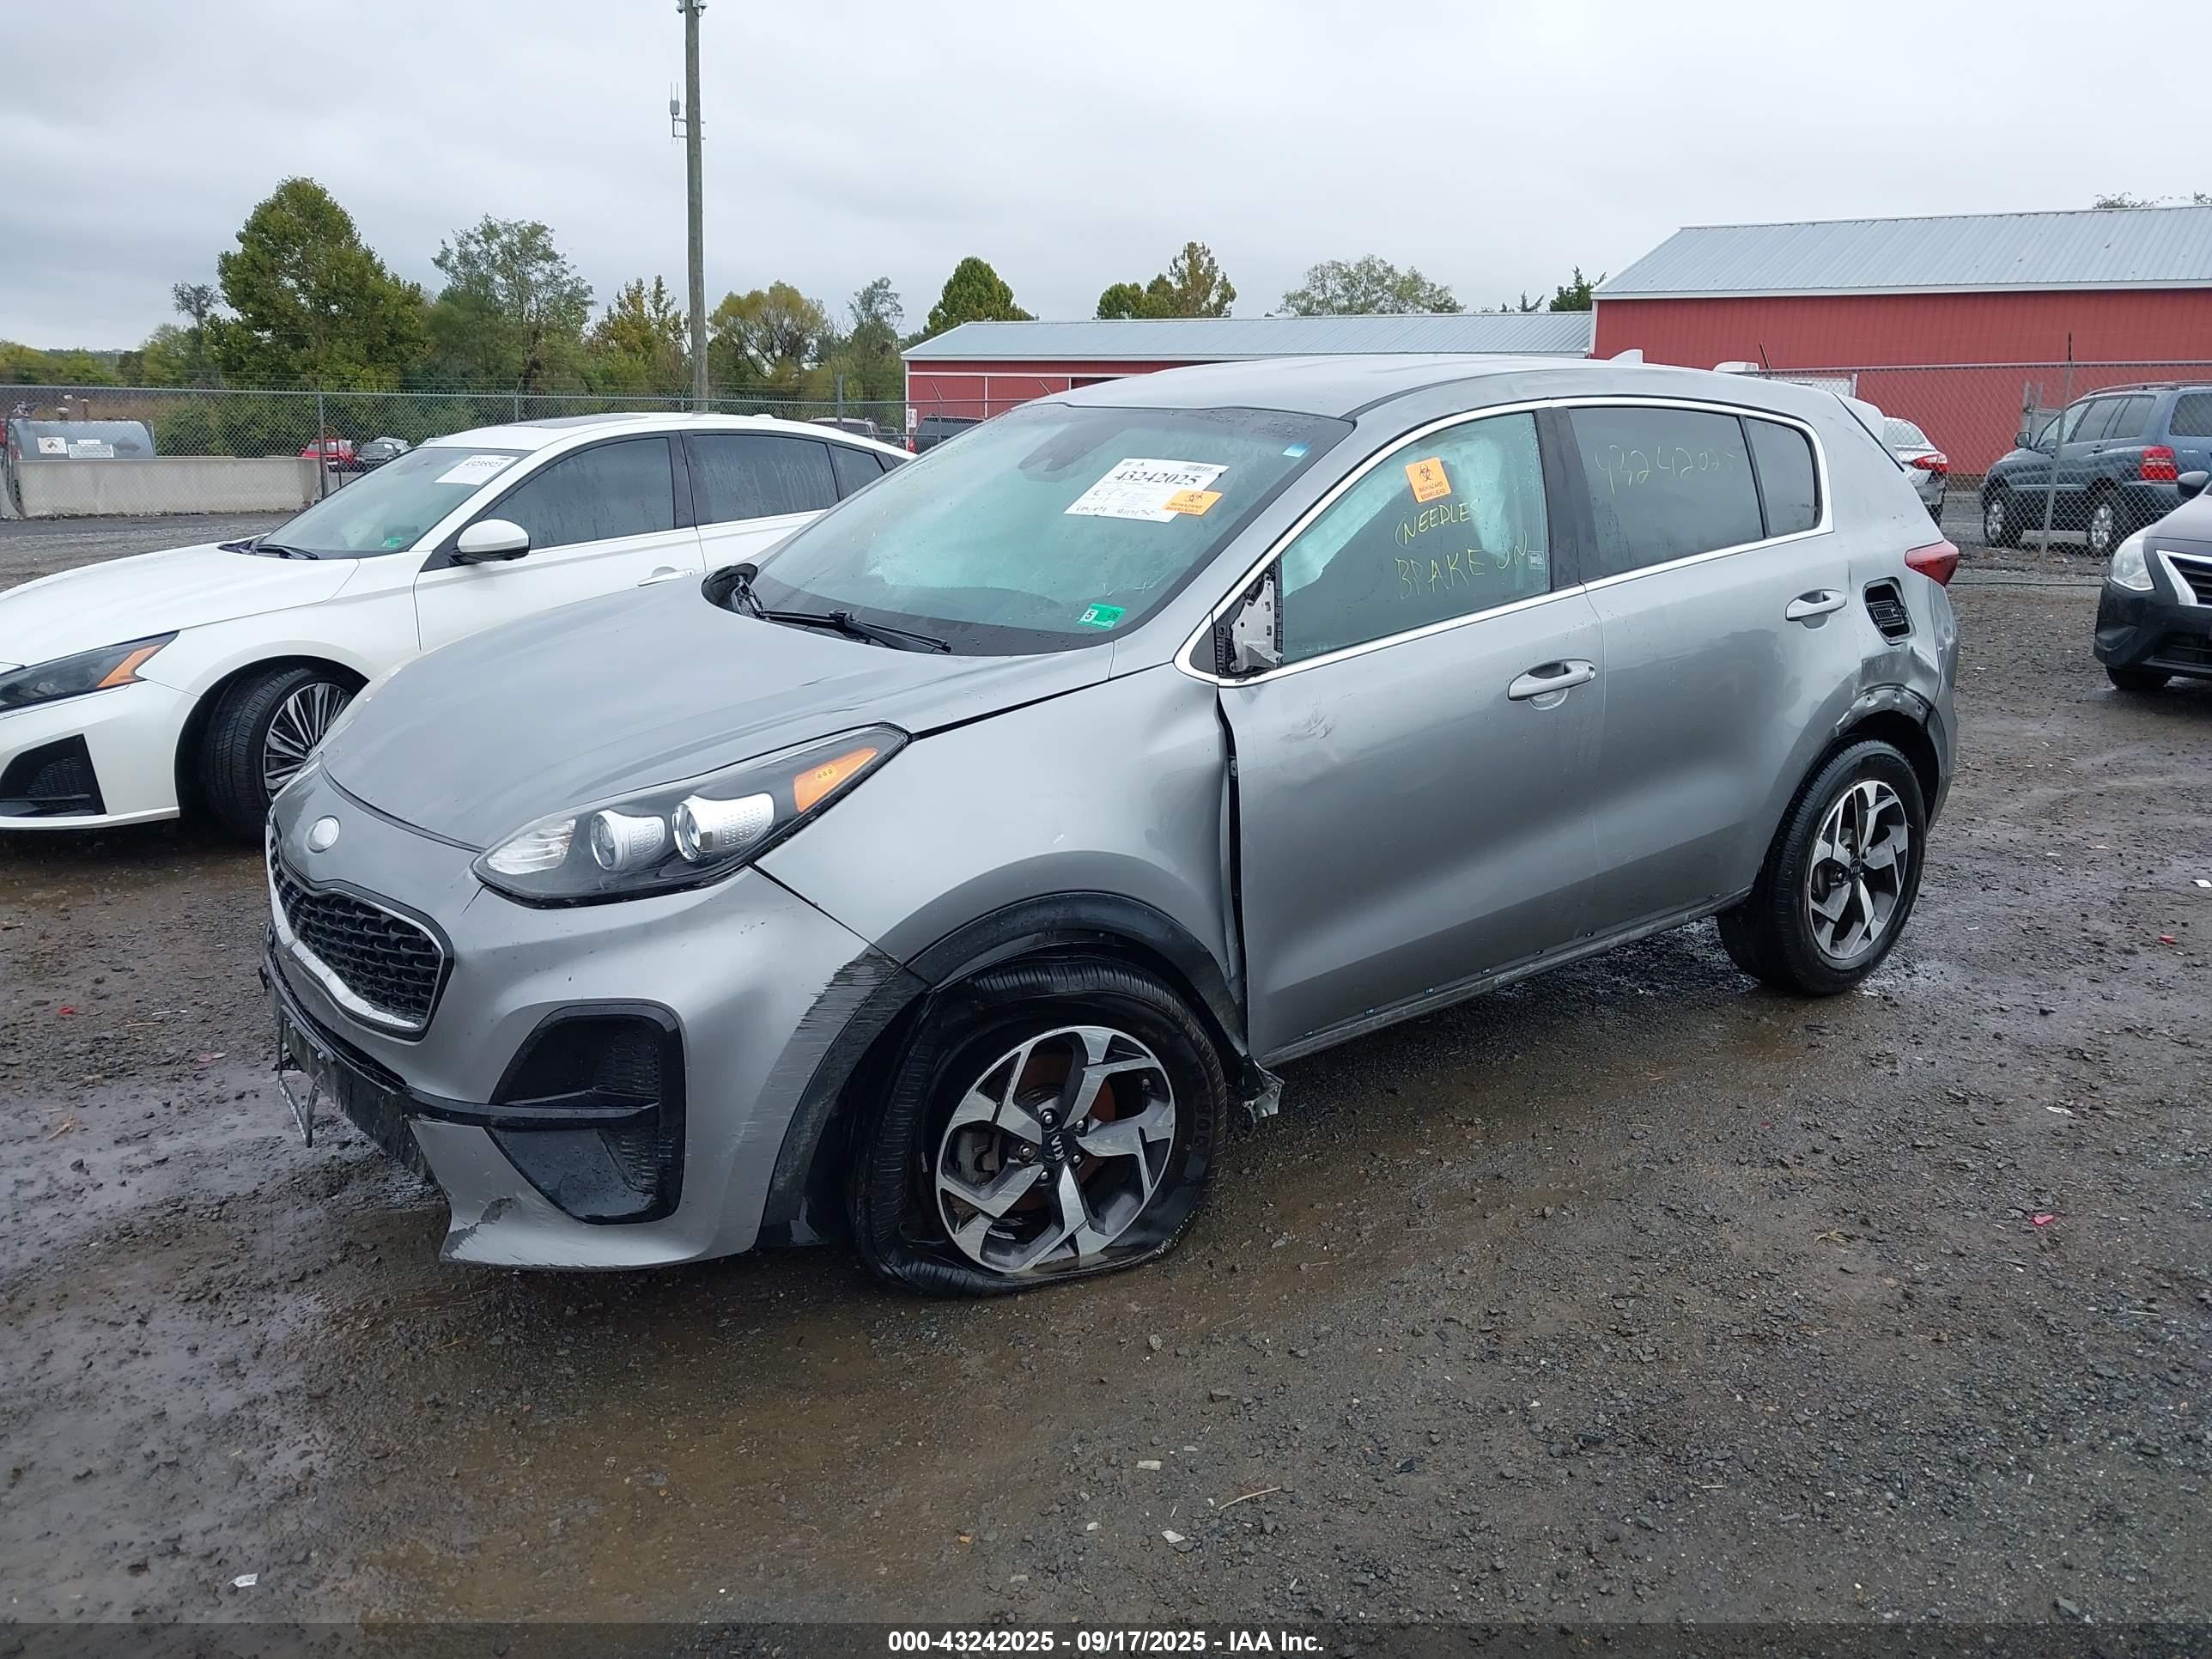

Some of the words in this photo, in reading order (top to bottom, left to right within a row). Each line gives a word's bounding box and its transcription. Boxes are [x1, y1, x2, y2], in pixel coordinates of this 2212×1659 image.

[1115, 470, 1203, 486] 43242025
[1595, 445, 1738, 495] 4324202
[1085, 611, 1095, 620] 5
[1107, 611, 1121, 619] 26
[1051, 1133, 1065, 1161] KIA
